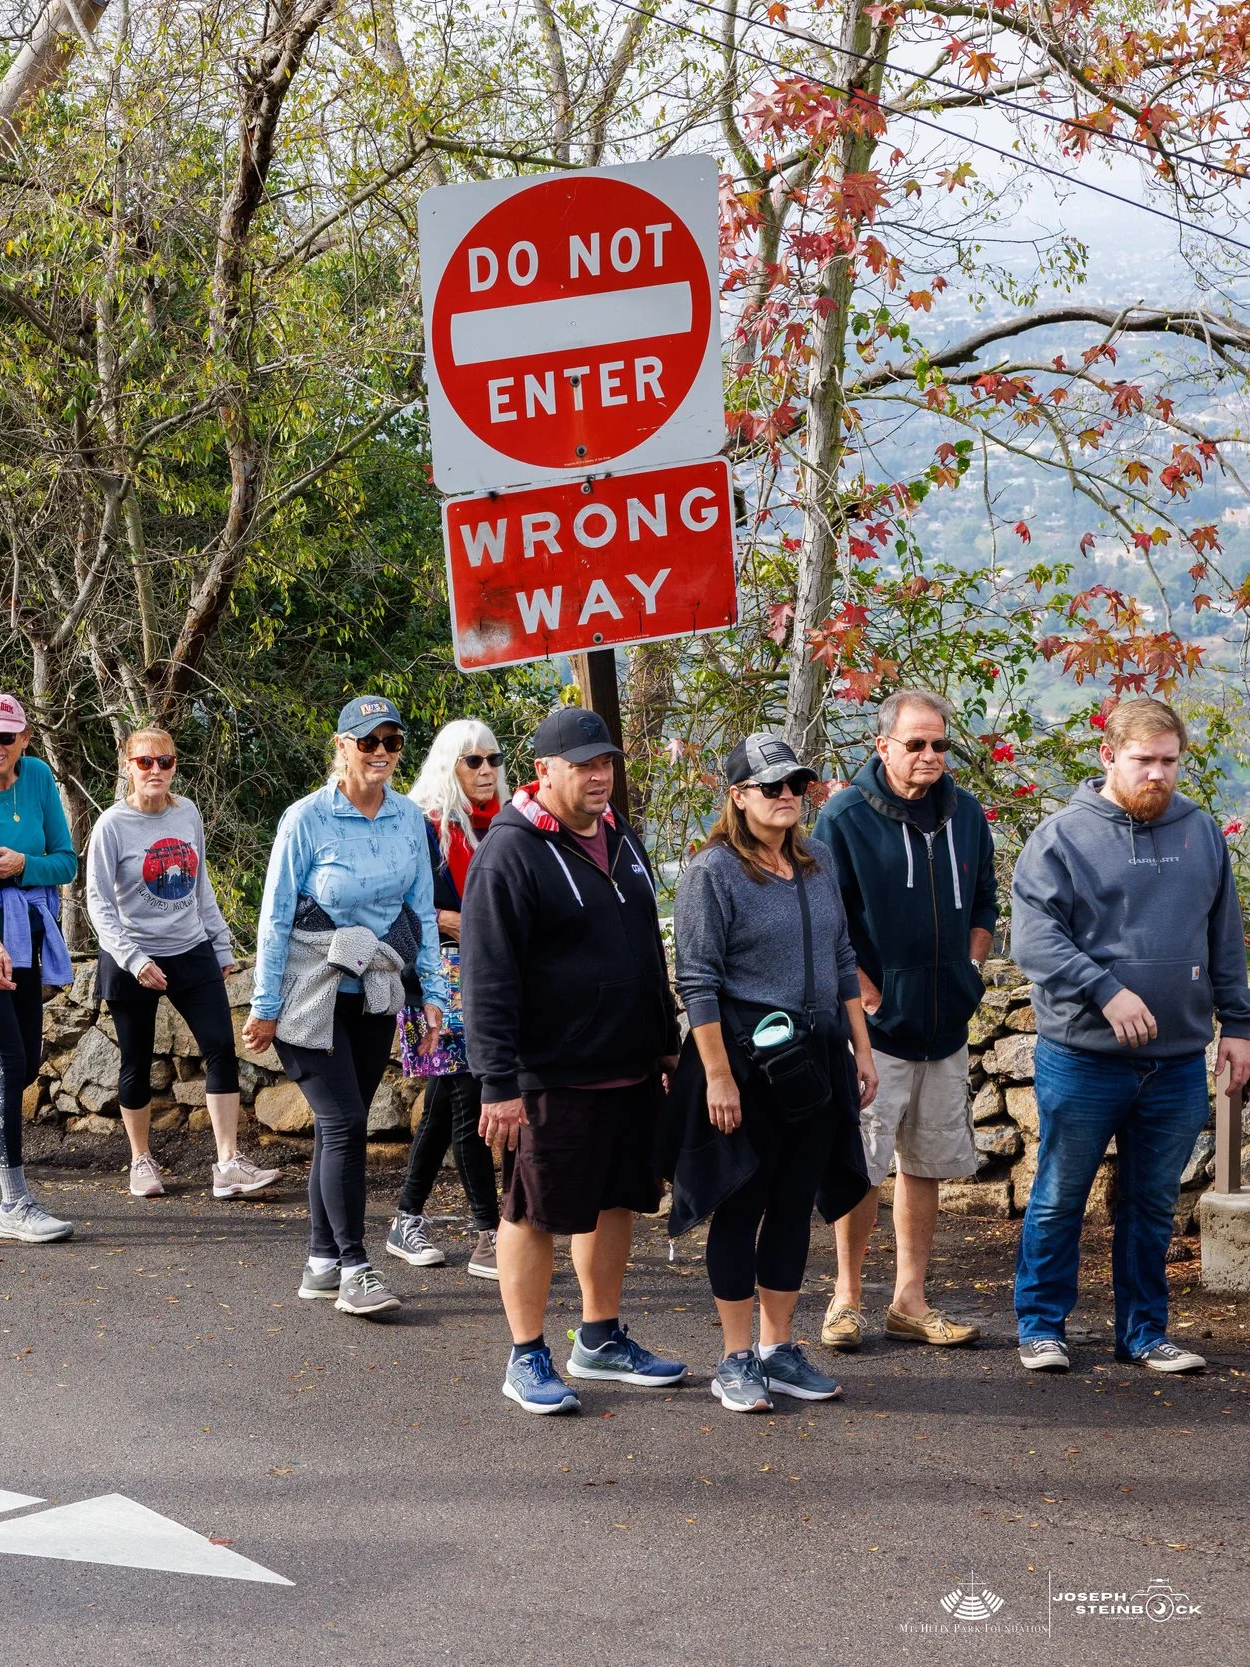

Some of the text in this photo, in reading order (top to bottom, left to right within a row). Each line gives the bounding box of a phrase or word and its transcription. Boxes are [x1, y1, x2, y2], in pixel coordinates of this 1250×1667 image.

[468, 222, 673, 293] DO NOT
[487, 356, 664, 424] ENTER
[459, 486, 719, 568] WRONG
[516, 567, 672, 634] WAY
